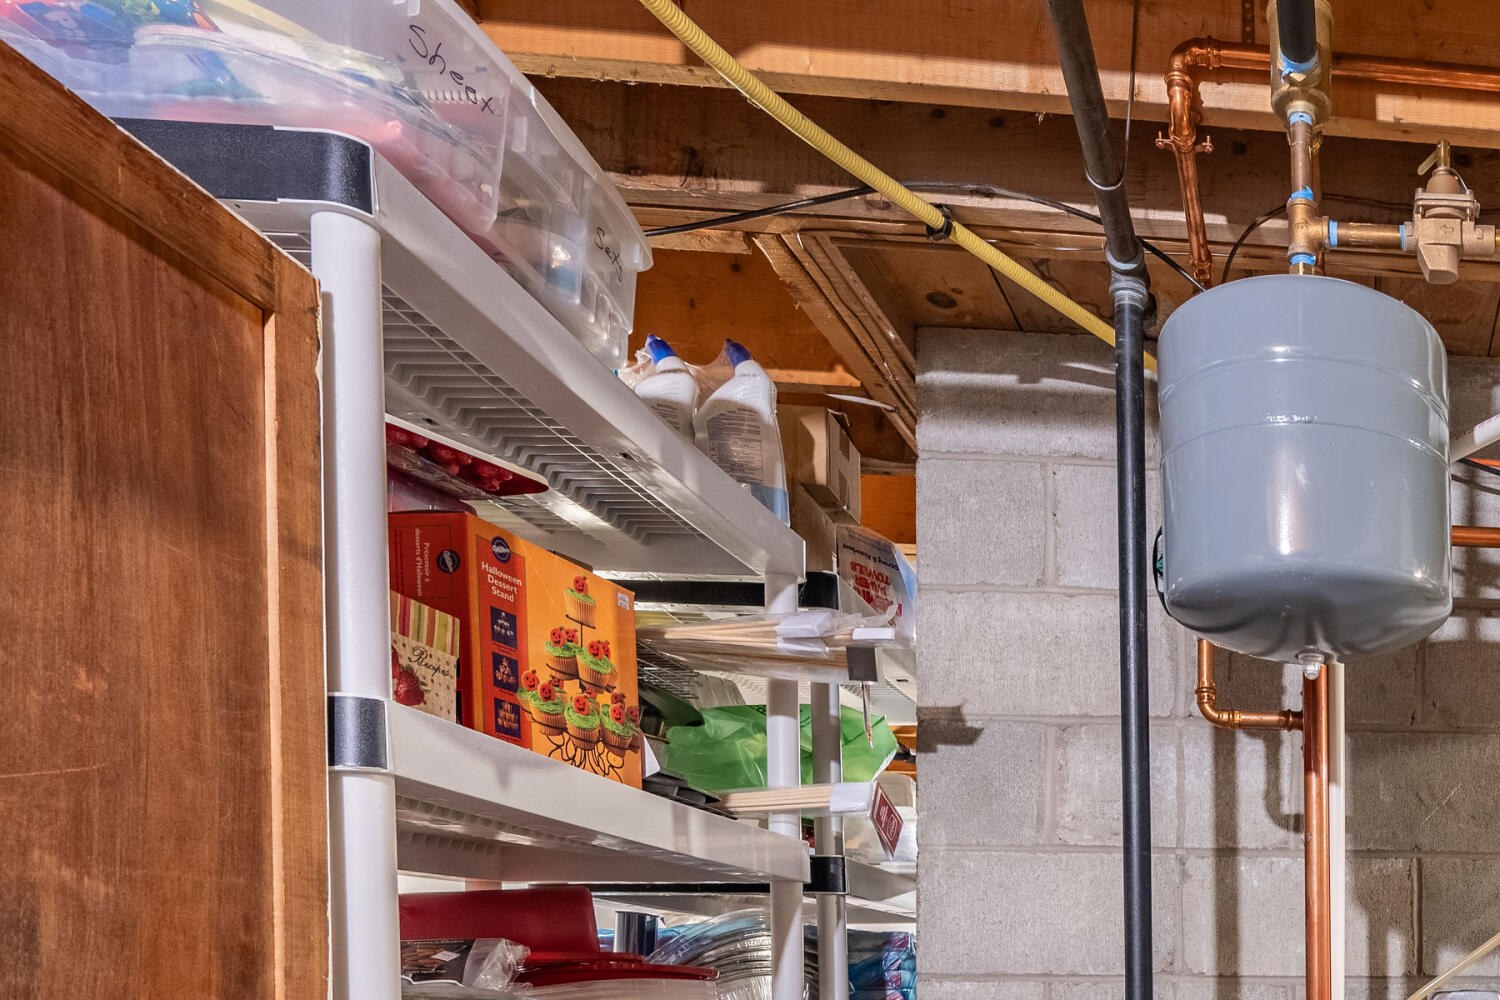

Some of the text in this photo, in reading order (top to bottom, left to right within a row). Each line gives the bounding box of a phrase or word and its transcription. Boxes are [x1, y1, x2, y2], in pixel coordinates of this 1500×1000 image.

[481, 561, 522, 587] Halloween
[487, 575, 518, 595] Dessert
[491, 586, 515, 603] Stand
[408, 645, 451, 678] Recipes
